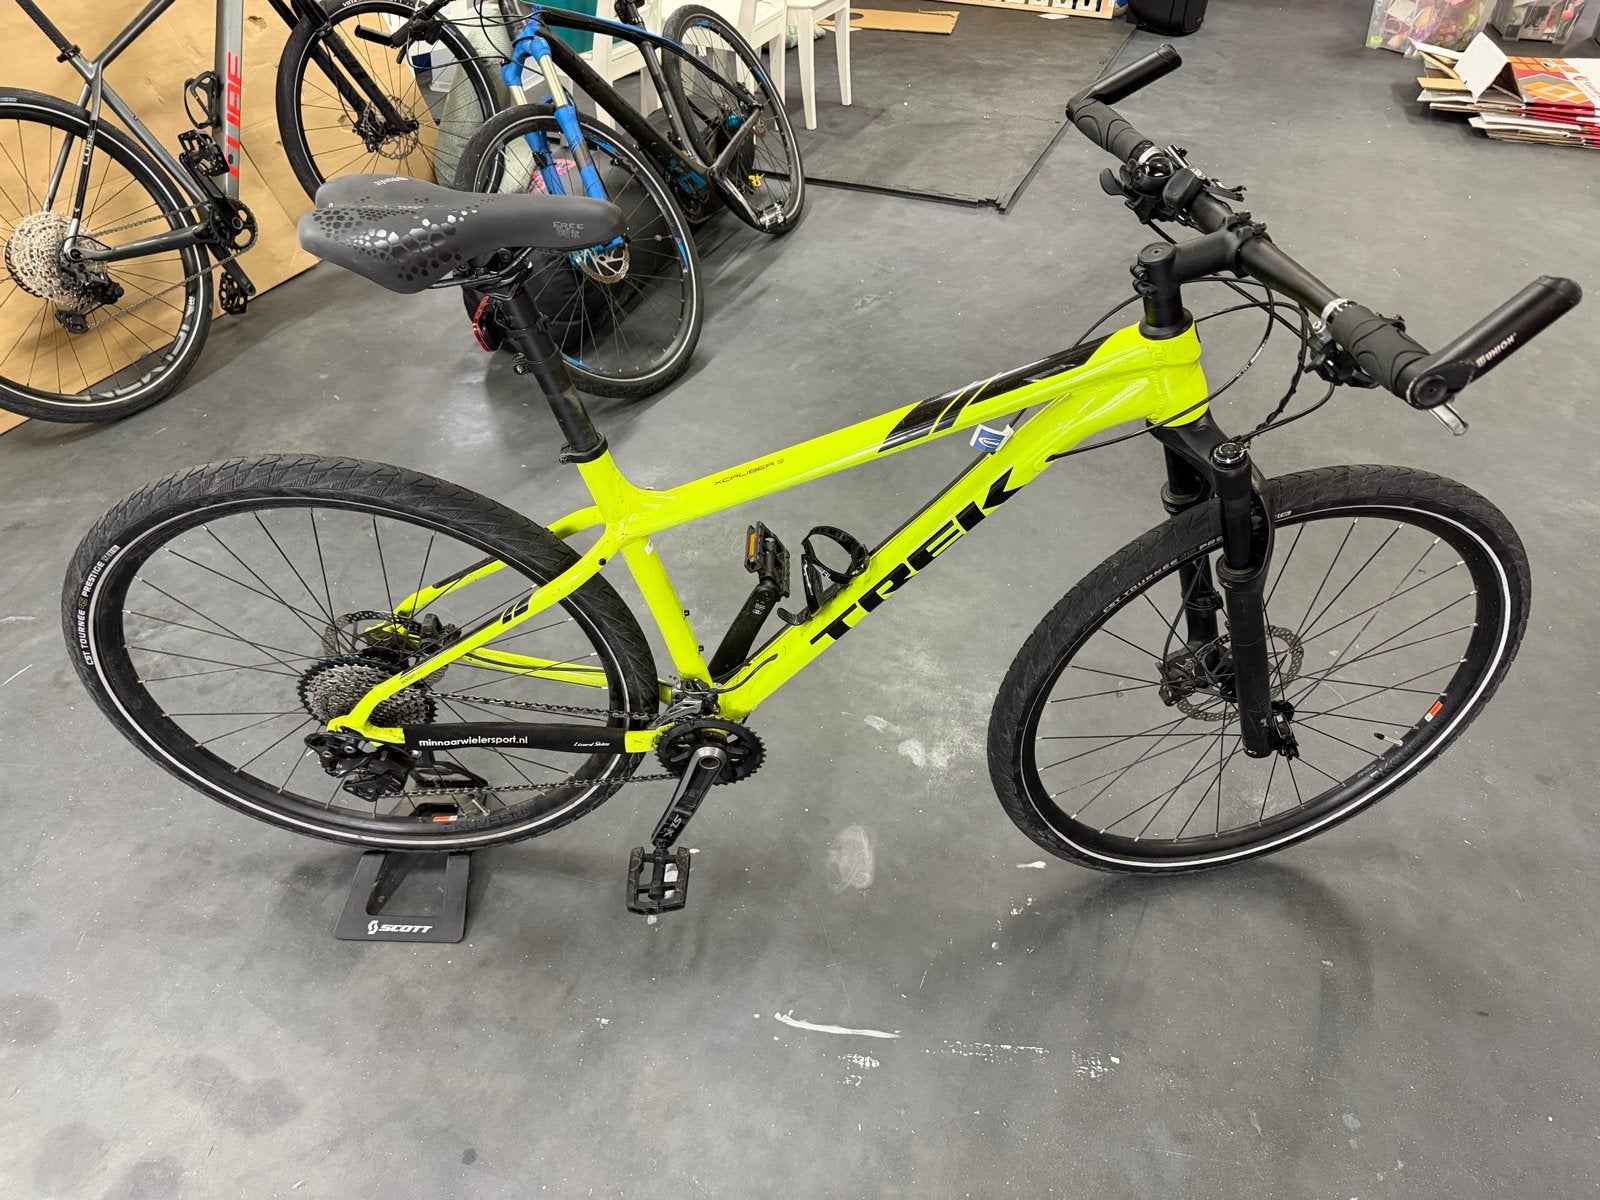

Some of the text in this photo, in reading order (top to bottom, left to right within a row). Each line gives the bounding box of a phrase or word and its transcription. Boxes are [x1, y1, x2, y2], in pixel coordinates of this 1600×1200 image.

[552, 221, 585, 230] FREE
[1485, 334, 1516, 361] UNION
[809, 466, 1026, 646] TREK
[82, 560, 106, 598] PRESTIGE
[1103, 597, 1122, 613] CST
[83, 651, 95, 666] CST
[418, 735, 528, 747] minnaarwielersport.nl
[378, 924, 433, 933] SCOTT
